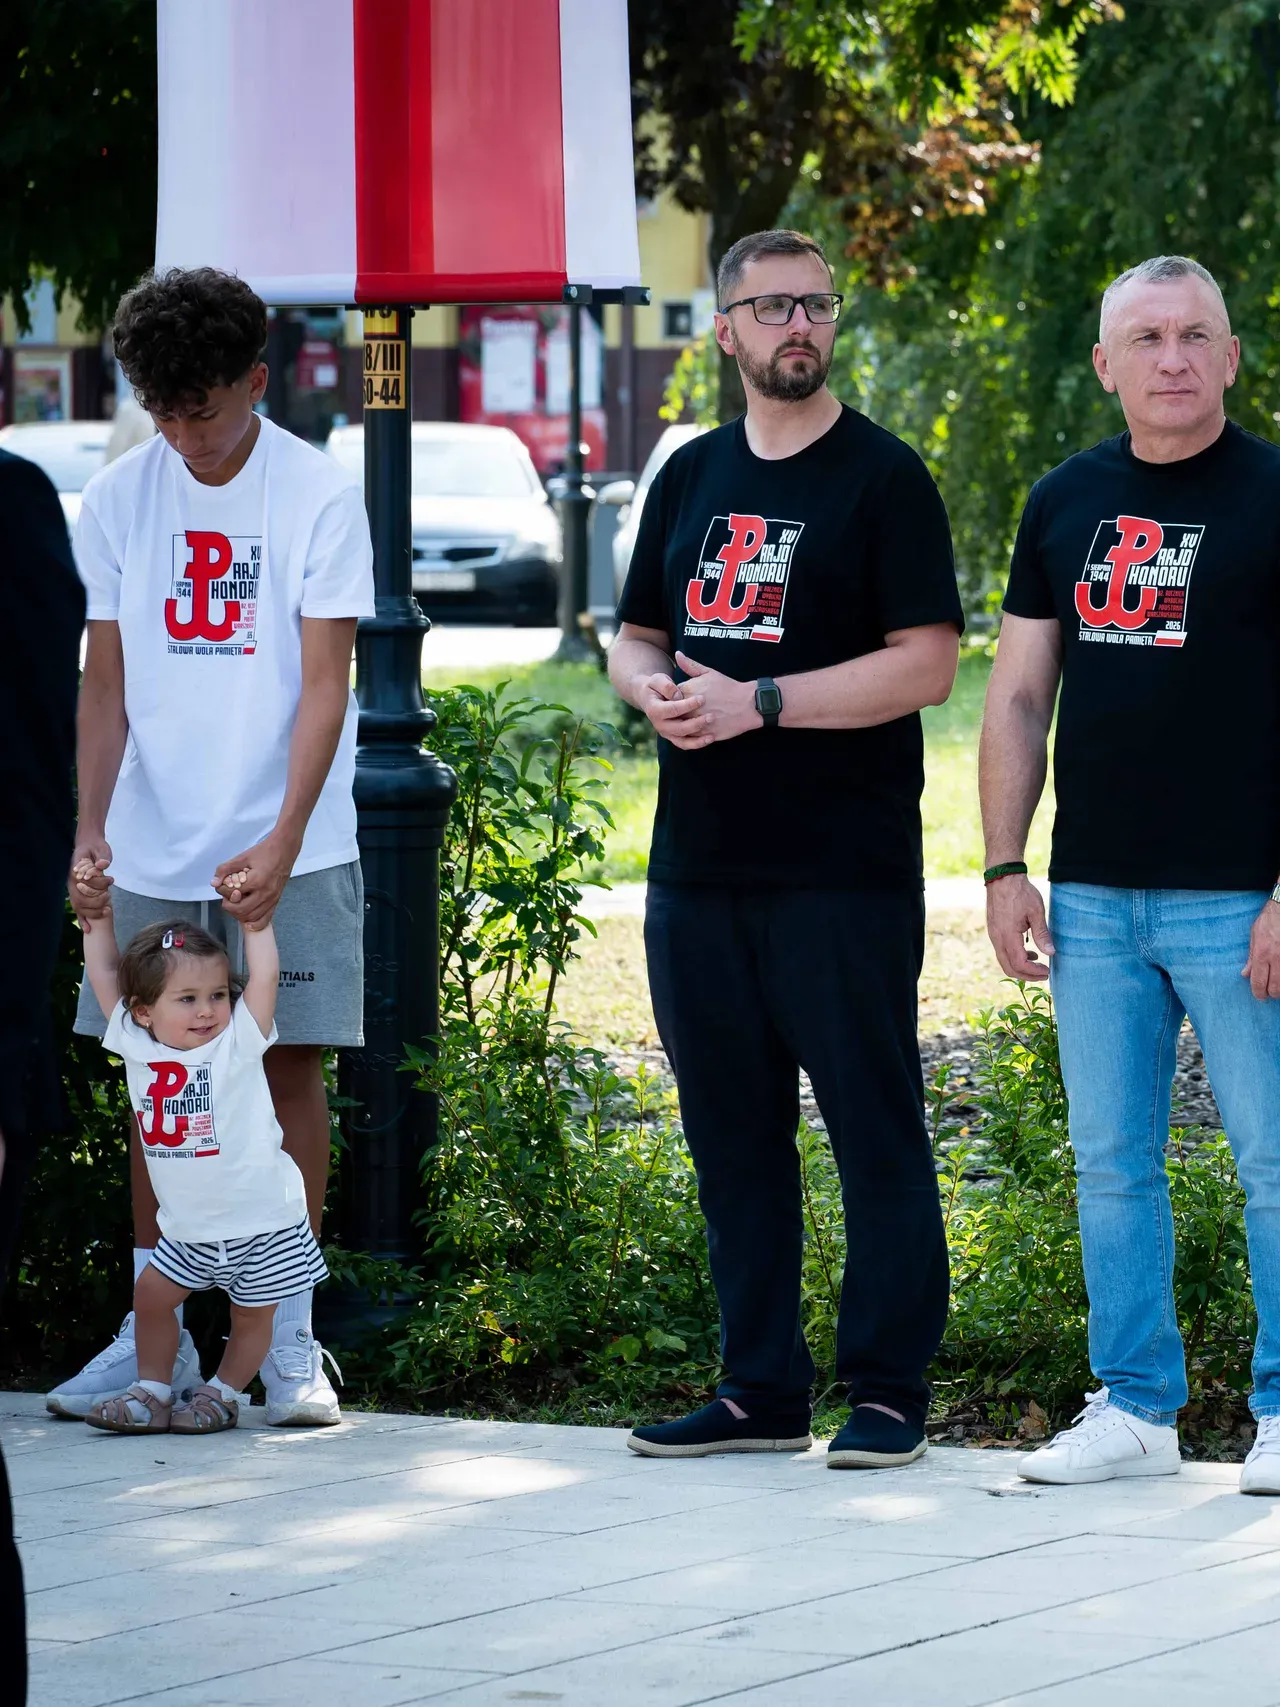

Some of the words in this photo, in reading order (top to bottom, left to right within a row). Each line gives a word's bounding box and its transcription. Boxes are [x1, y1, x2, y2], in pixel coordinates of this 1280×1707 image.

[779, 529, 797, 543] XV
[1180, 533, 1199, 548] XV
[760, 544, 791, 563] RAJD
[1156, 548, 1193, 566] RAJD
[703, 569, 721, 580] 1944
[737, 564, 787, 583] HONORU
[1090, 571, 1110, 582] 1944
[1128, 566, 1188, 586] HONORU
[176, 588, 191, 598] 1944
[762, 616, 778, 625] 2026
[1165, 621, 1181, 630] 2026
[1079, 631, 1105, 642] STALOWA
[1106, 633, 1124, 644] WOLA
[168, 645, 193, 654] STALOWA
[195, 646, 213, 655] WOLA
[196, 1069, 208, 1081] XV
[164, 1097, 209, 1115] HONORU
